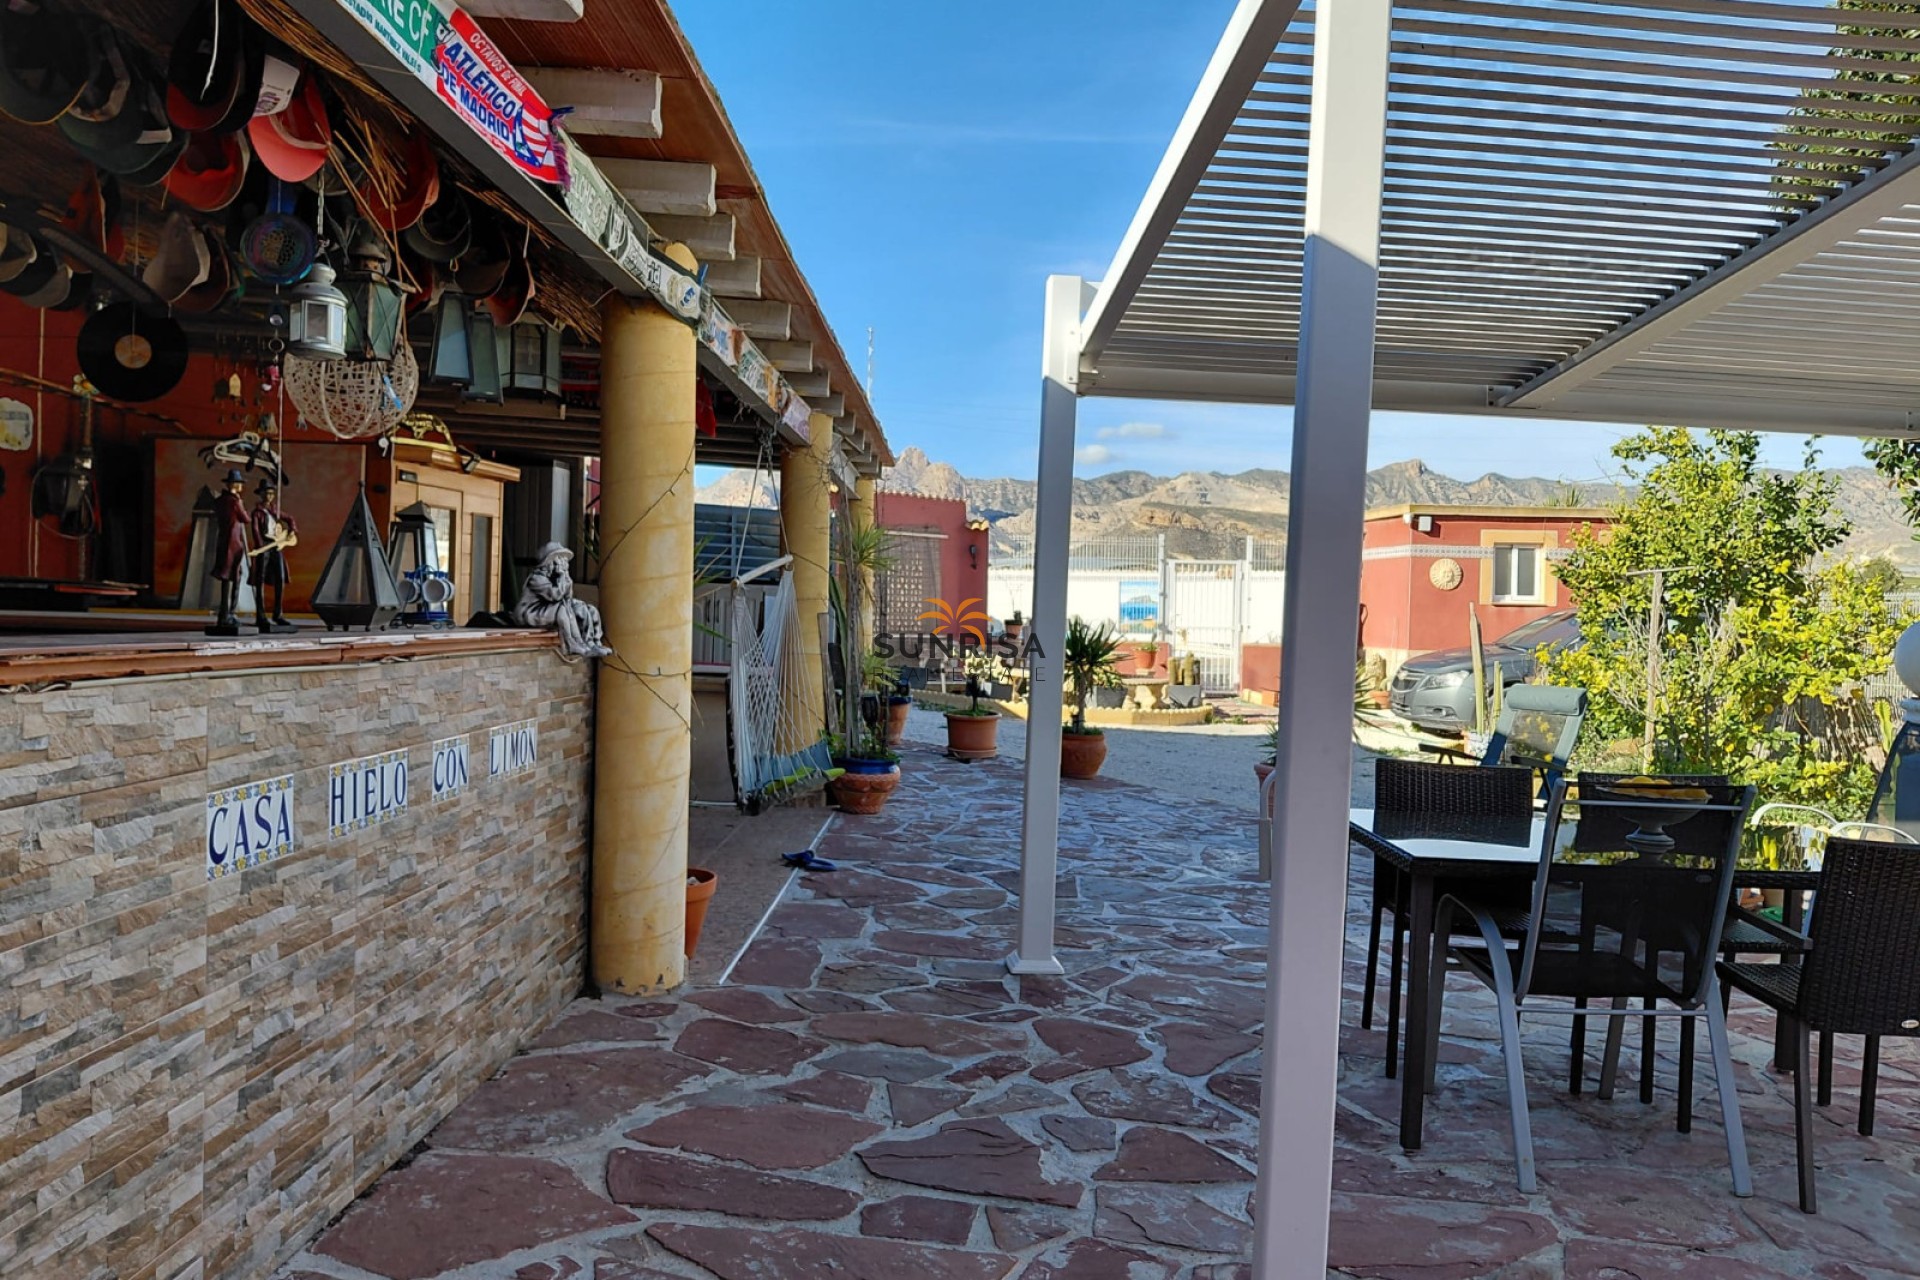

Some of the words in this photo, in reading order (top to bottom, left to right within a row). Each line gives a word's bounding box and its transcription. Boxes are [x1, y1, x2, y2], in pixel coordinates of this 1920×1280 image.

[344, 0, 373, 23] STADIO
[409, 0, 432, 45] CF
[444, 42, 516, 118] ATLÉTICO
[470, 32, 505, 72] OCTAVOS
[501, 70, 514, 81] DE
[508, 77, 527, 97] FINAL
[441, 62, 457, 95] DE
[460, 85, 510, 142] MADRID
[208, 792, 291, 865] CASA
[331, 762, 407, 827] HIELO
[433, 744, 469, 793] CON
[490, 729, 537, 776] LIMON
